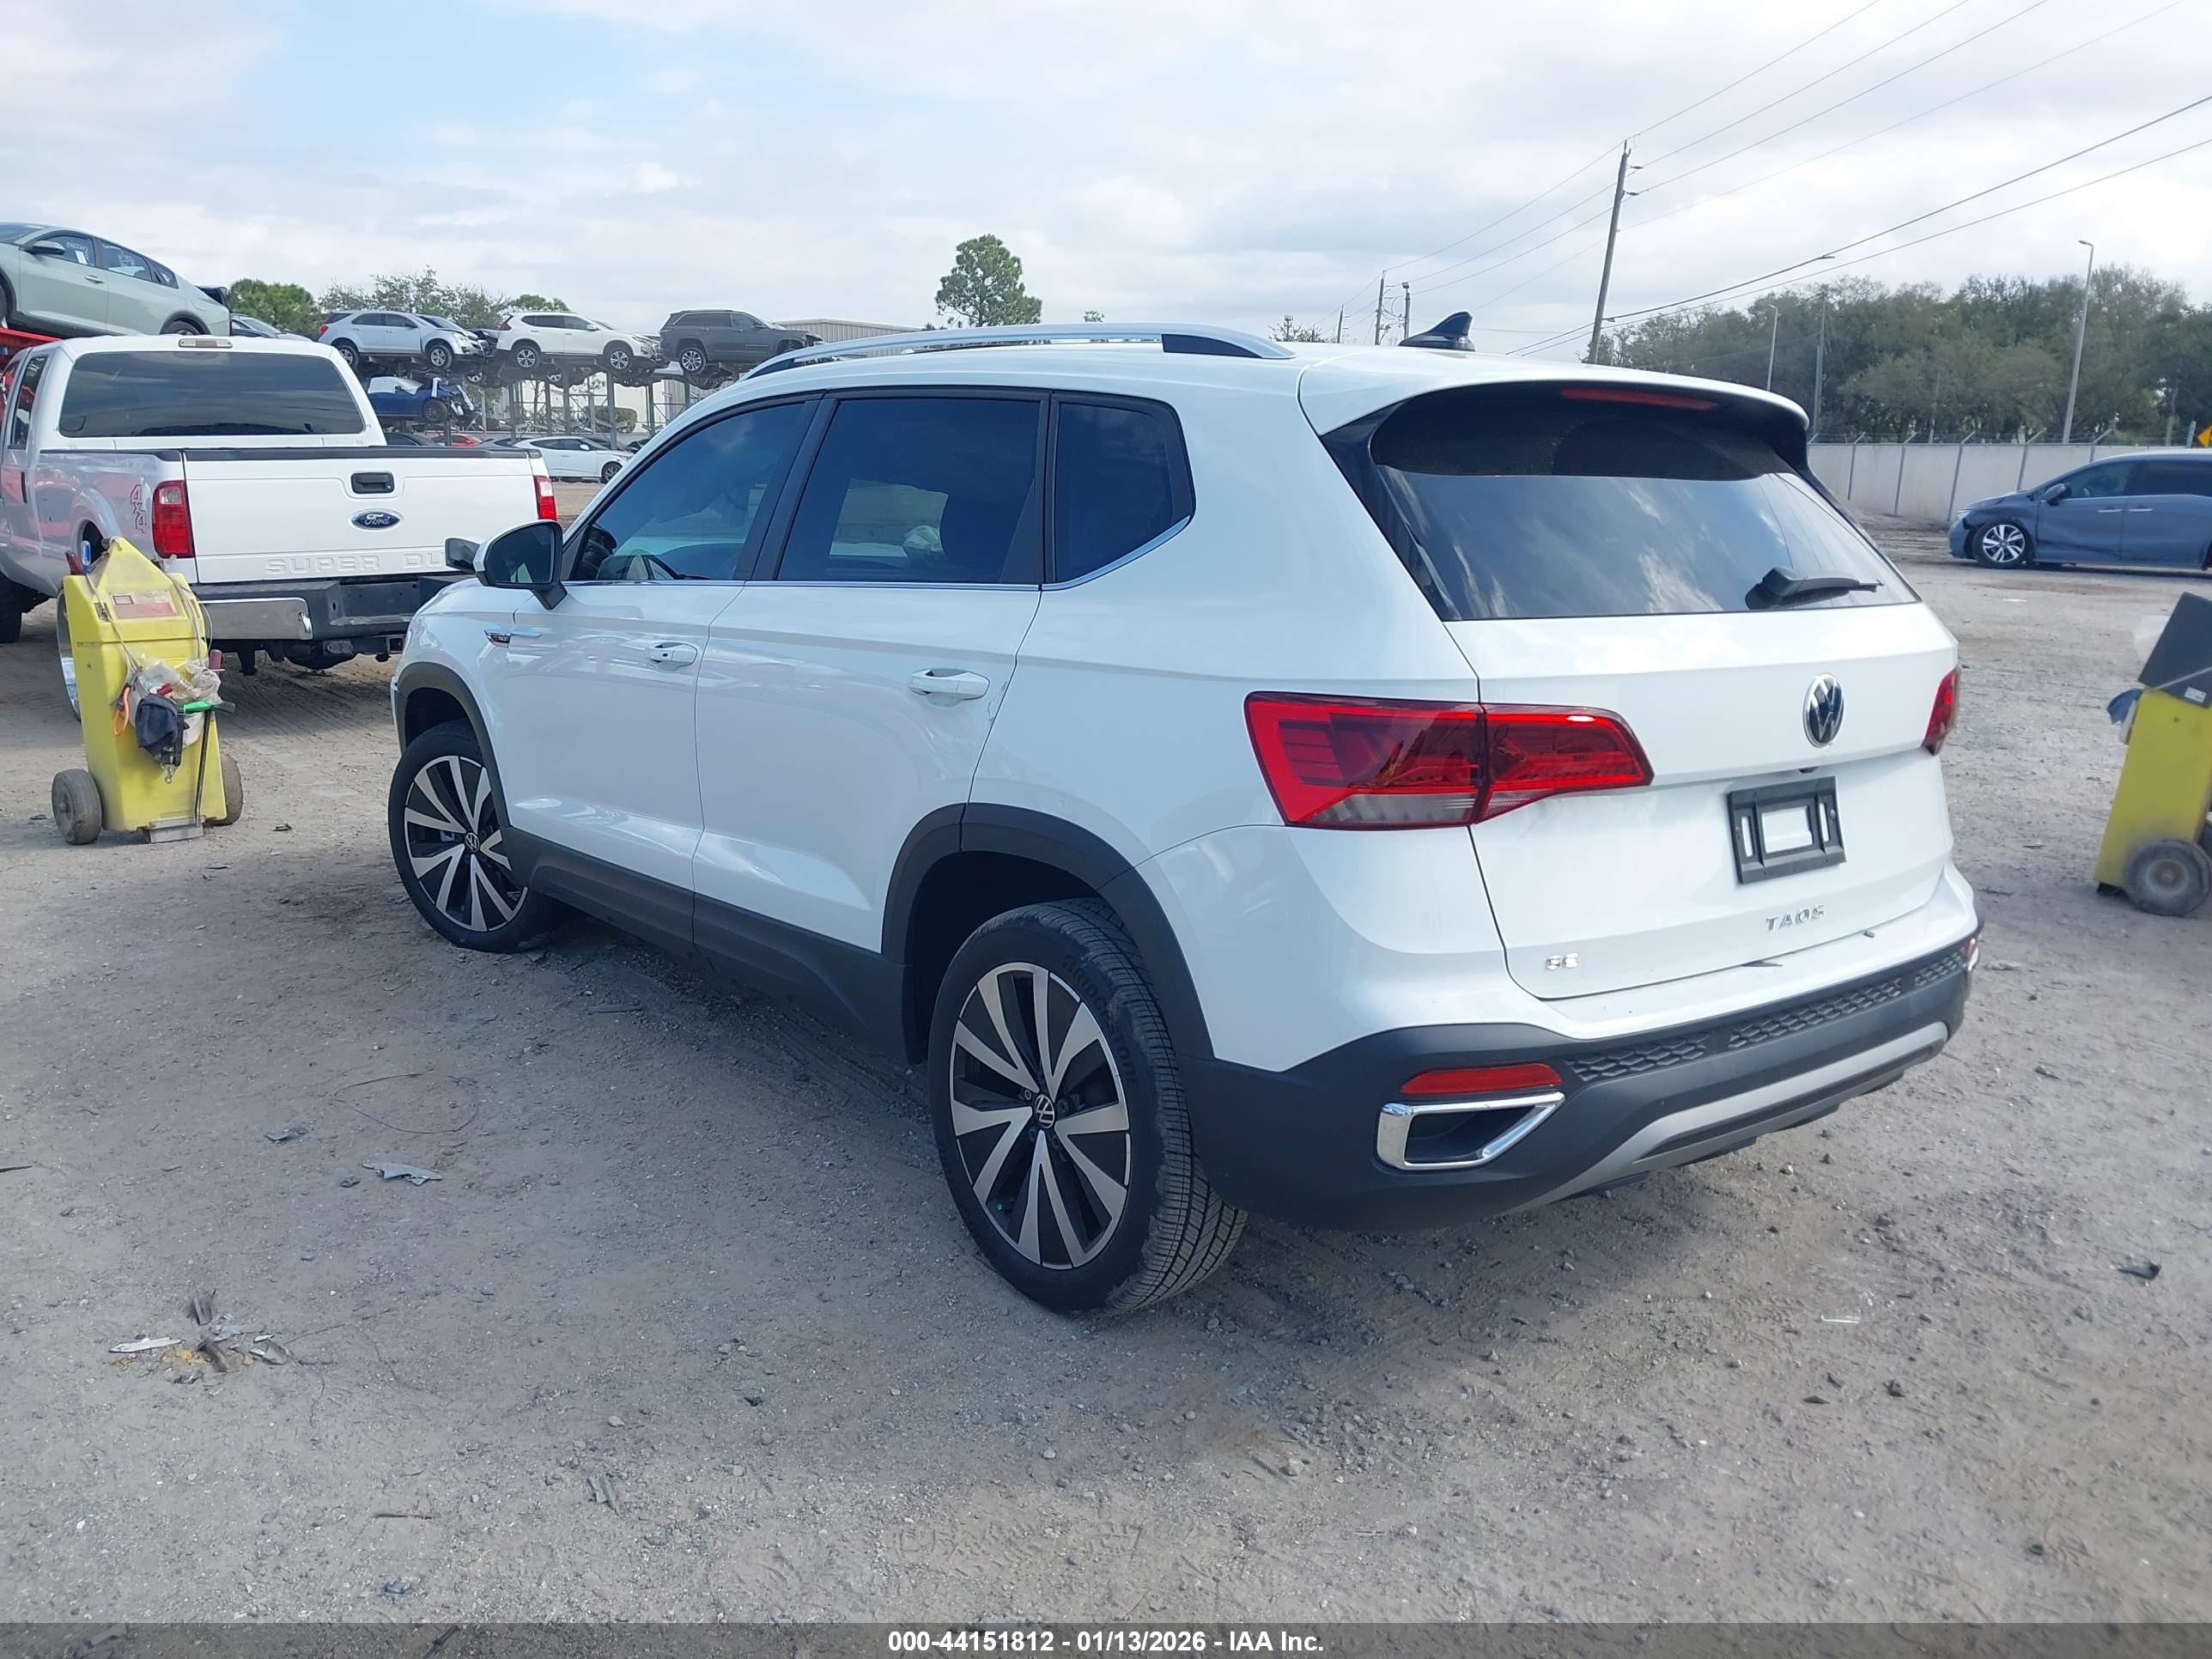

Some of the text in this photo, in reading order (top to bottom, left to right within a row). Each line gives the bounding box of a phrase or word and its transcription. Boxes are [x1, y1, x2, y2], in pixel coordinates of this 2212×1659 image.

[364, 513, 391, 526] Ford
[264, 552, 446, 574] SUPER DU
[1765, 902, 1826, 932] TAOS
[1545, 952, 1579, 971] SE
